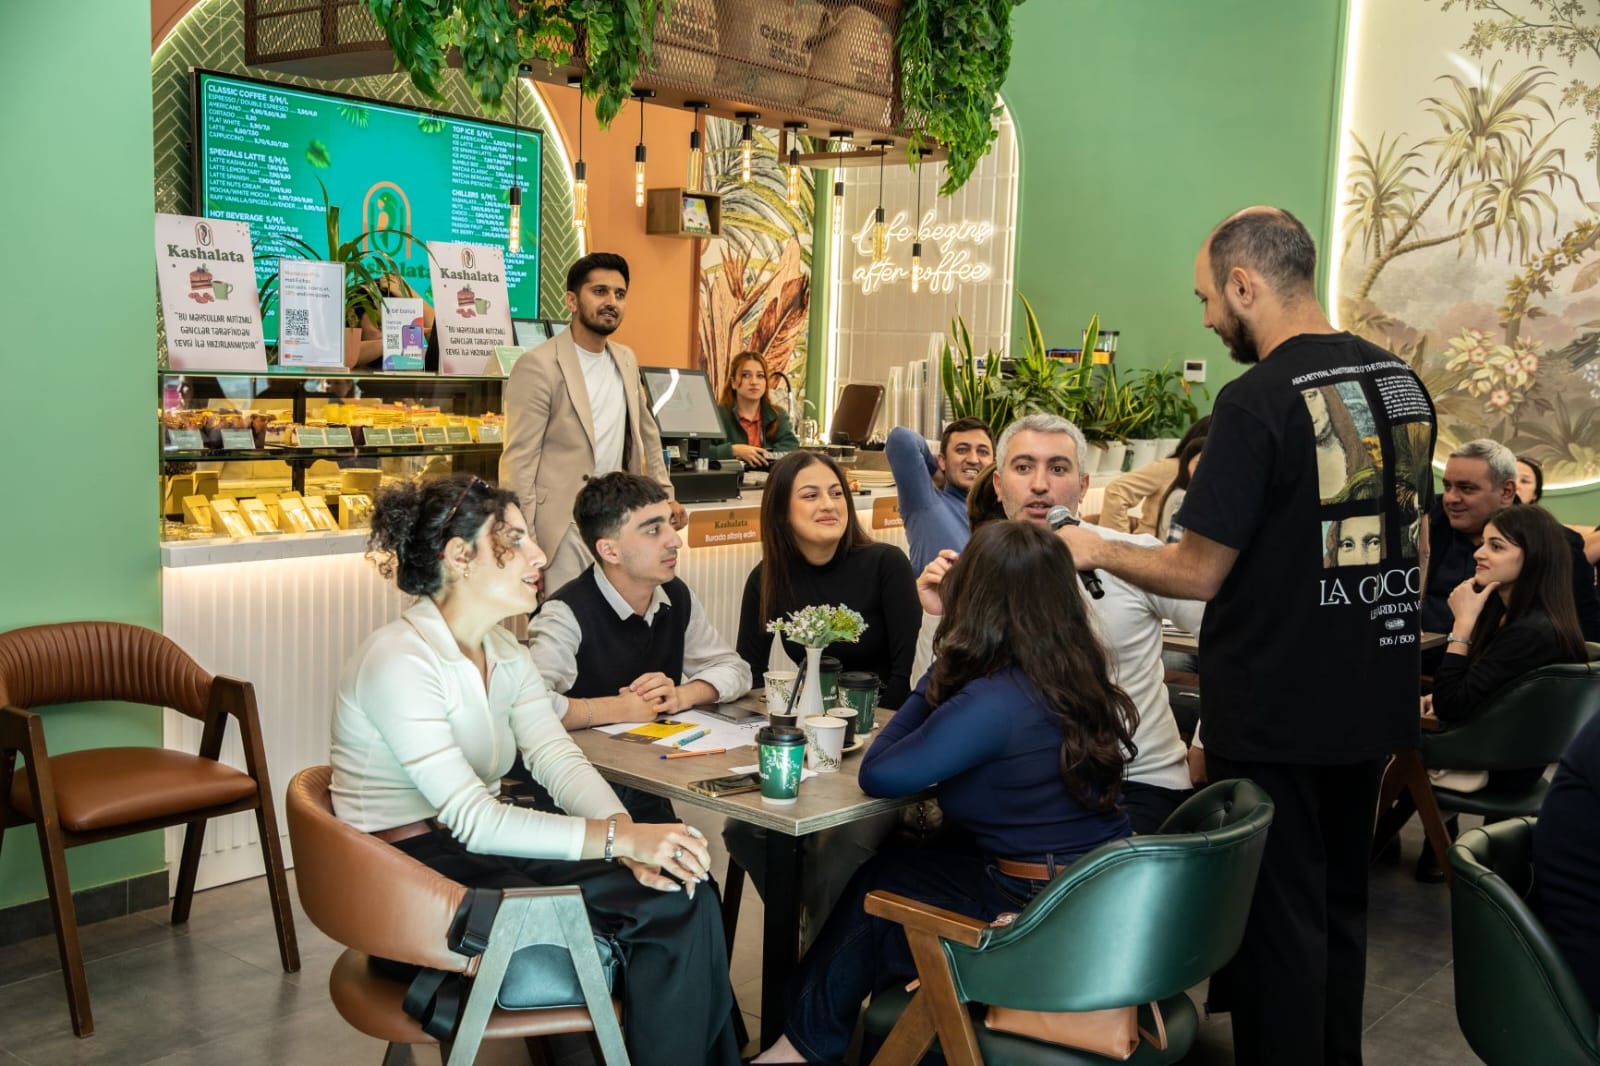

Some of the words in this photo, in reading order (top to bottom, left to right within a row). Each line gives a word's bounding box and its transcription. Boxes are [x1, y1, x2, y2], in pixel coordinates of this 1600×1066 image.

[208, 85, 238, 96] CLASSIC
[239, 90, 267, 101] COFFEE
[209, 93, 236, 103] ESPRESSO
[209, 102, 241, 111] AMERICANO
[209, 109, 235, 118] CORTADO
[209, 131, 244, 142] CAPPUCCINO
[209, 148, 243, 159] SPECIALS
[244, 152, 266, 162] LATTE
[452, 189, 478, 199] CHILLERS
[226, 212, 264, 222] BEVERAGE
[266, 216, 286, 225] S/M/L
[852, 208, 912, 256] Lfe
[918, 208, 994, 254] begins
[167, 244, 245, 262] Kashalata
[440, 268, 500, 283] Kashalata
[853, 257, 908, 295] after
[914, 249, 991, 294] coffee
[714, 520, 748, 529] Kashalata
[1320, 577, 1352, 606] LA
[1398, 602, 1414, 613] DA
